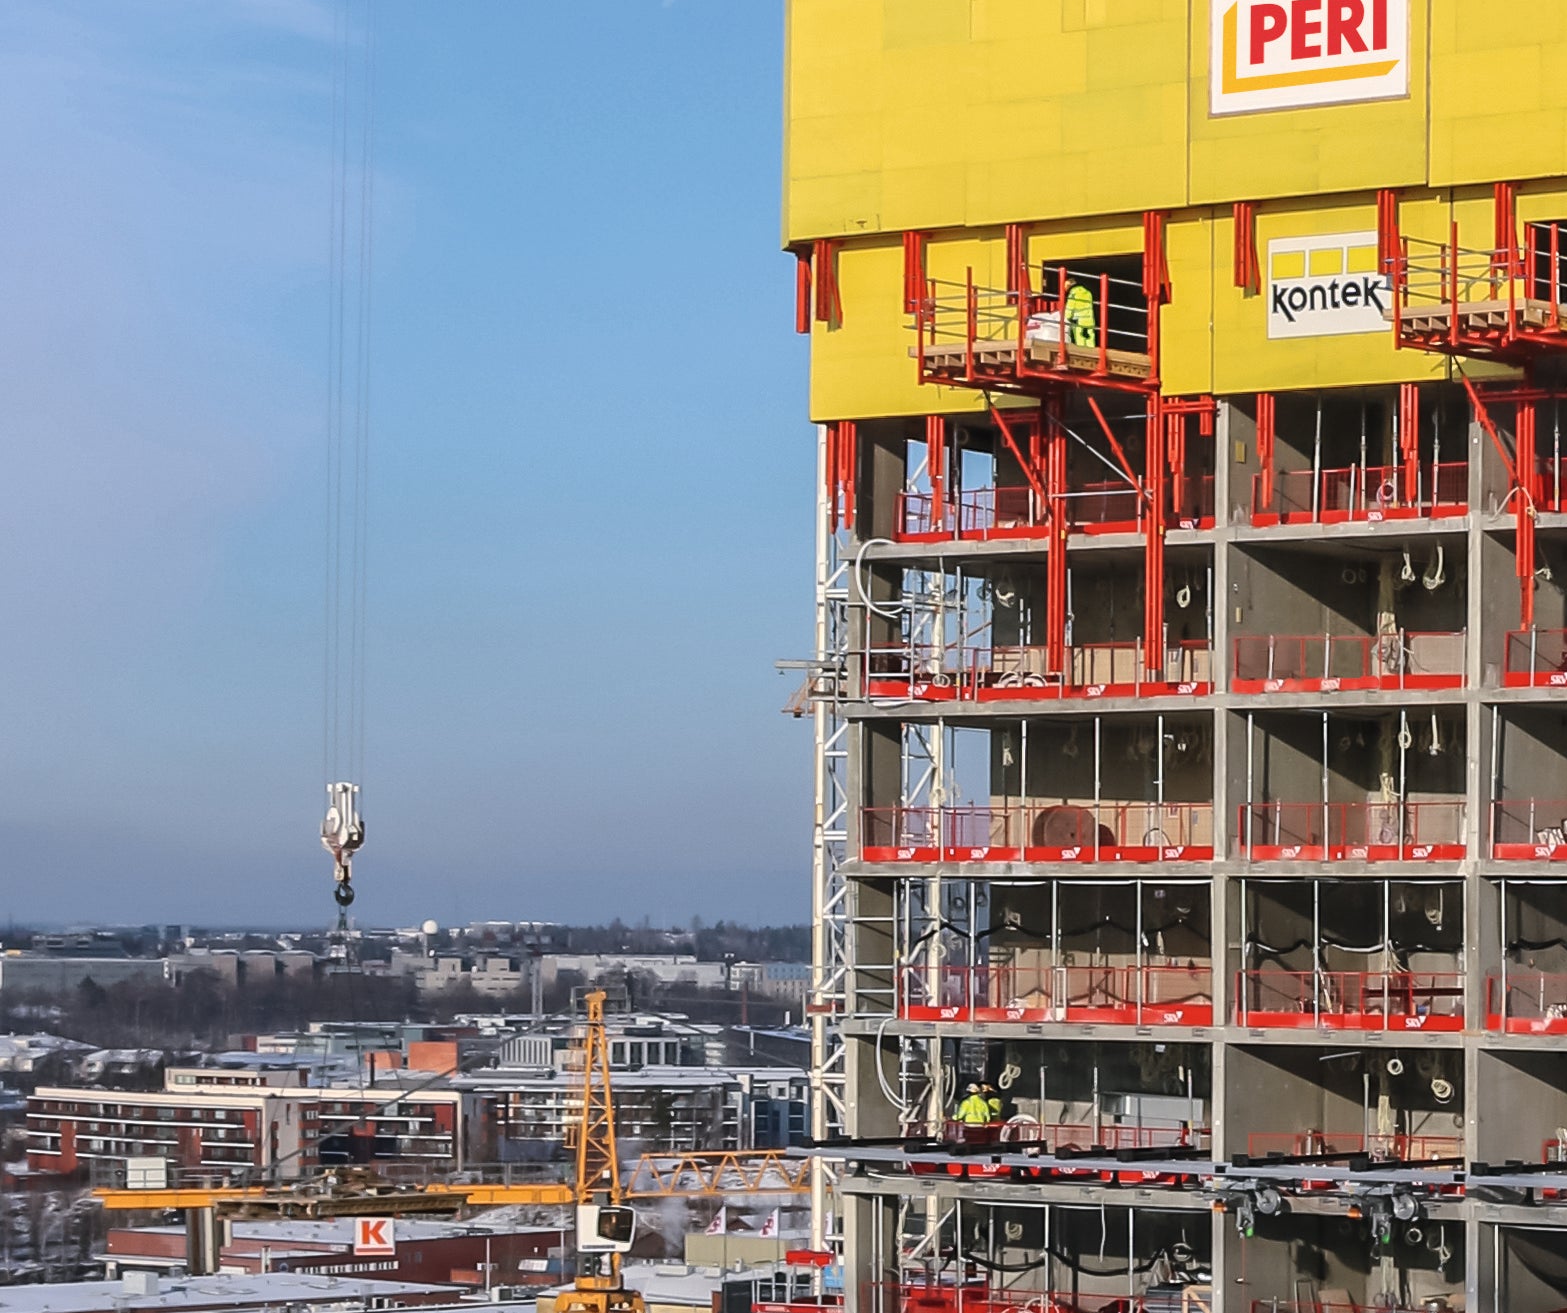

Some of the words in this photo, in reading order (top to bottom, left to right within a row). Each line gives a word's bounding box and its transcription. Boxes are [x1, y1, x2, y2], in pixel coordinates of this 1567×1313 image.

[1272, 277, 1384, 322] kontek
[1087, 685, 1105, 696] SRV
[1178, 682, 1197, 694] SRV
[898, 848, 916, 859] SRV
[971, 848, 988, 858] SRV
[1062, 847, 1080, 859] SRV
[1165, 847, 1183, 858] SRV
[1413, 846, 1432, 857] SRV
[941, 1007, 959, 1018] SRV
[1164, 1011, 1182, 1023] SRV
[1406, 1016, 1426, 1027] SRV
[362, 1221, 387, 1244] K
